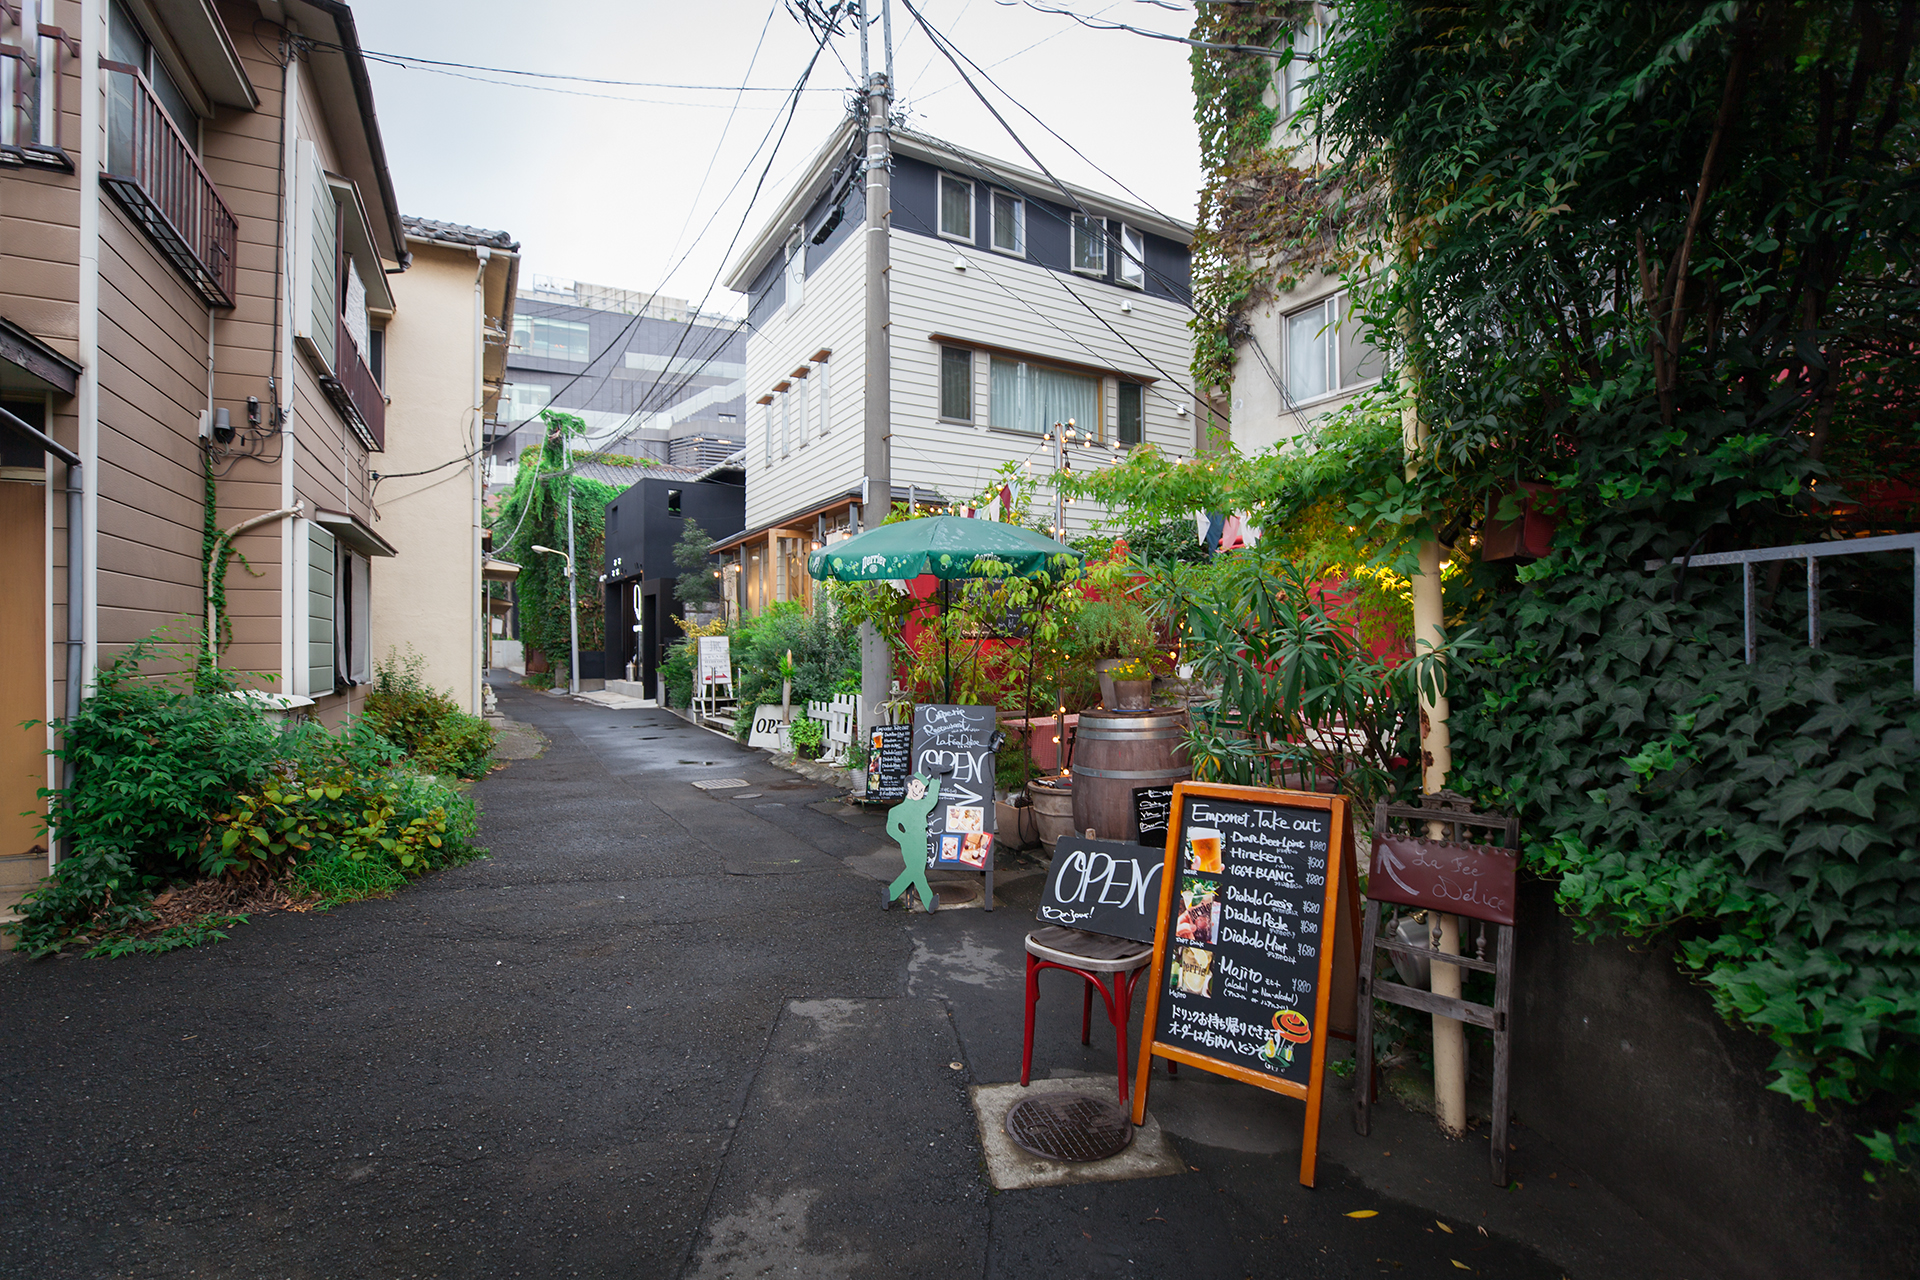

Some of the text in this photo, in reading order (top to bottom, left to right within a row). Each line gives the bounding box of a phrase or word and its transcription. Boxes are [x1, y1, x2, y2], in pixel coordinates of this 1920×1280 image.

[918, 750, 993, 784] OPEN
[1253, 809, 1290, 831] Take
[1293, 819, 1321, 832] out
[1231, 847, 1284, 864] Hineken
[1412, 849, 1485, 877] La Fée
[1055, 851, 1164, 915] OPEN
[1256, 866, 1295, 883] BLANC
[1227, 886, 1262, 906] Diabolo
[1303, 900, 1320, 914] ¥680
[1432, 875, 1505, 911] Délice
[1225, 904, 1261, 925] Diabolo
[1300, 920, 1318, 934] ¥680
[1222, 926, 1264, 949] Diabolo
[1265, 933, 1288, 954] Mint
[1298, 943, 1316, 957] ¥680
[1220, 955, 1262, 983] Mojito
[1292, 978, 1311, 993] ¥880
